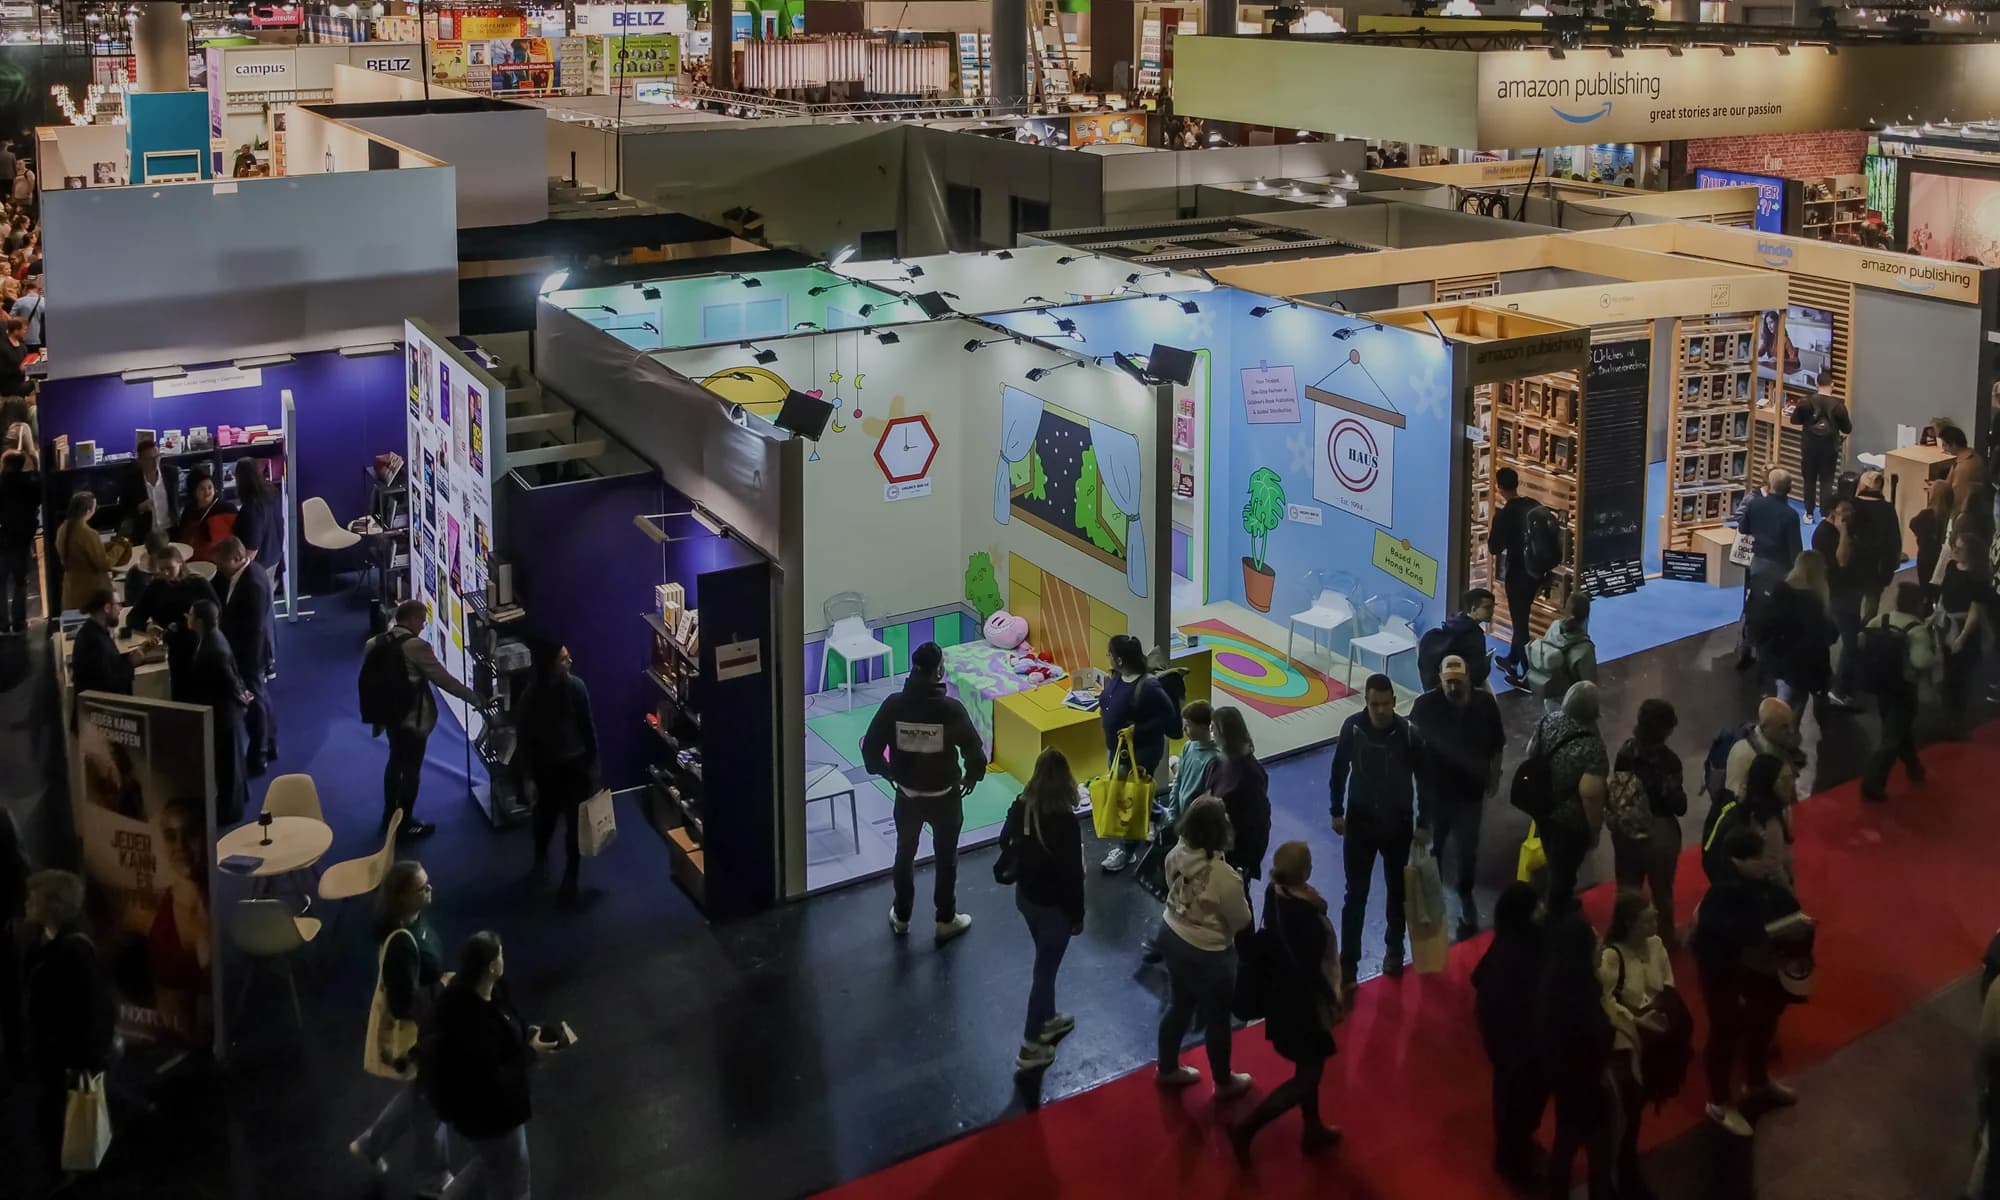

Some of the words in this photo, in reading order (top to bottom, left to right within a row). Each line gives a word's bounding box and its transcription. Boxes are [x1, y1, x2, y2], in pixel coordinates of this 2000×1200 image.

[613, 12, 665, 26] BELTZ
[235, 63, 286, 75] campus
[367, 59, 410, 71] BELTZ
[1497, 78, 1569, 99] amazon
[1575, 72, 1661, 101] publishing
[1650, 107, 1676, 123] great
[1678, 104, 1710, 119] stories
[1712, 106, 1728, 117] are
[1730, 105, 1746, 116] our
[1748, 102, 1782, 118] passion
[1757, 240, 1793, 259] kindle
[1861, 259, 1907, 277] amazon
[1909, 264, 1971, 288] publishing
[1477, 344, 1525, 365] amazon
[1526, 336, 1583, 360] publishing
[1348, 447, 1379, 469] HAUS
[1390, 546, 1411, 564] Based
[1413, 559, 1421, 569] in
[1384, 555, 1403, 575] Hong
[1405, 567, 1424, 586] Kong
